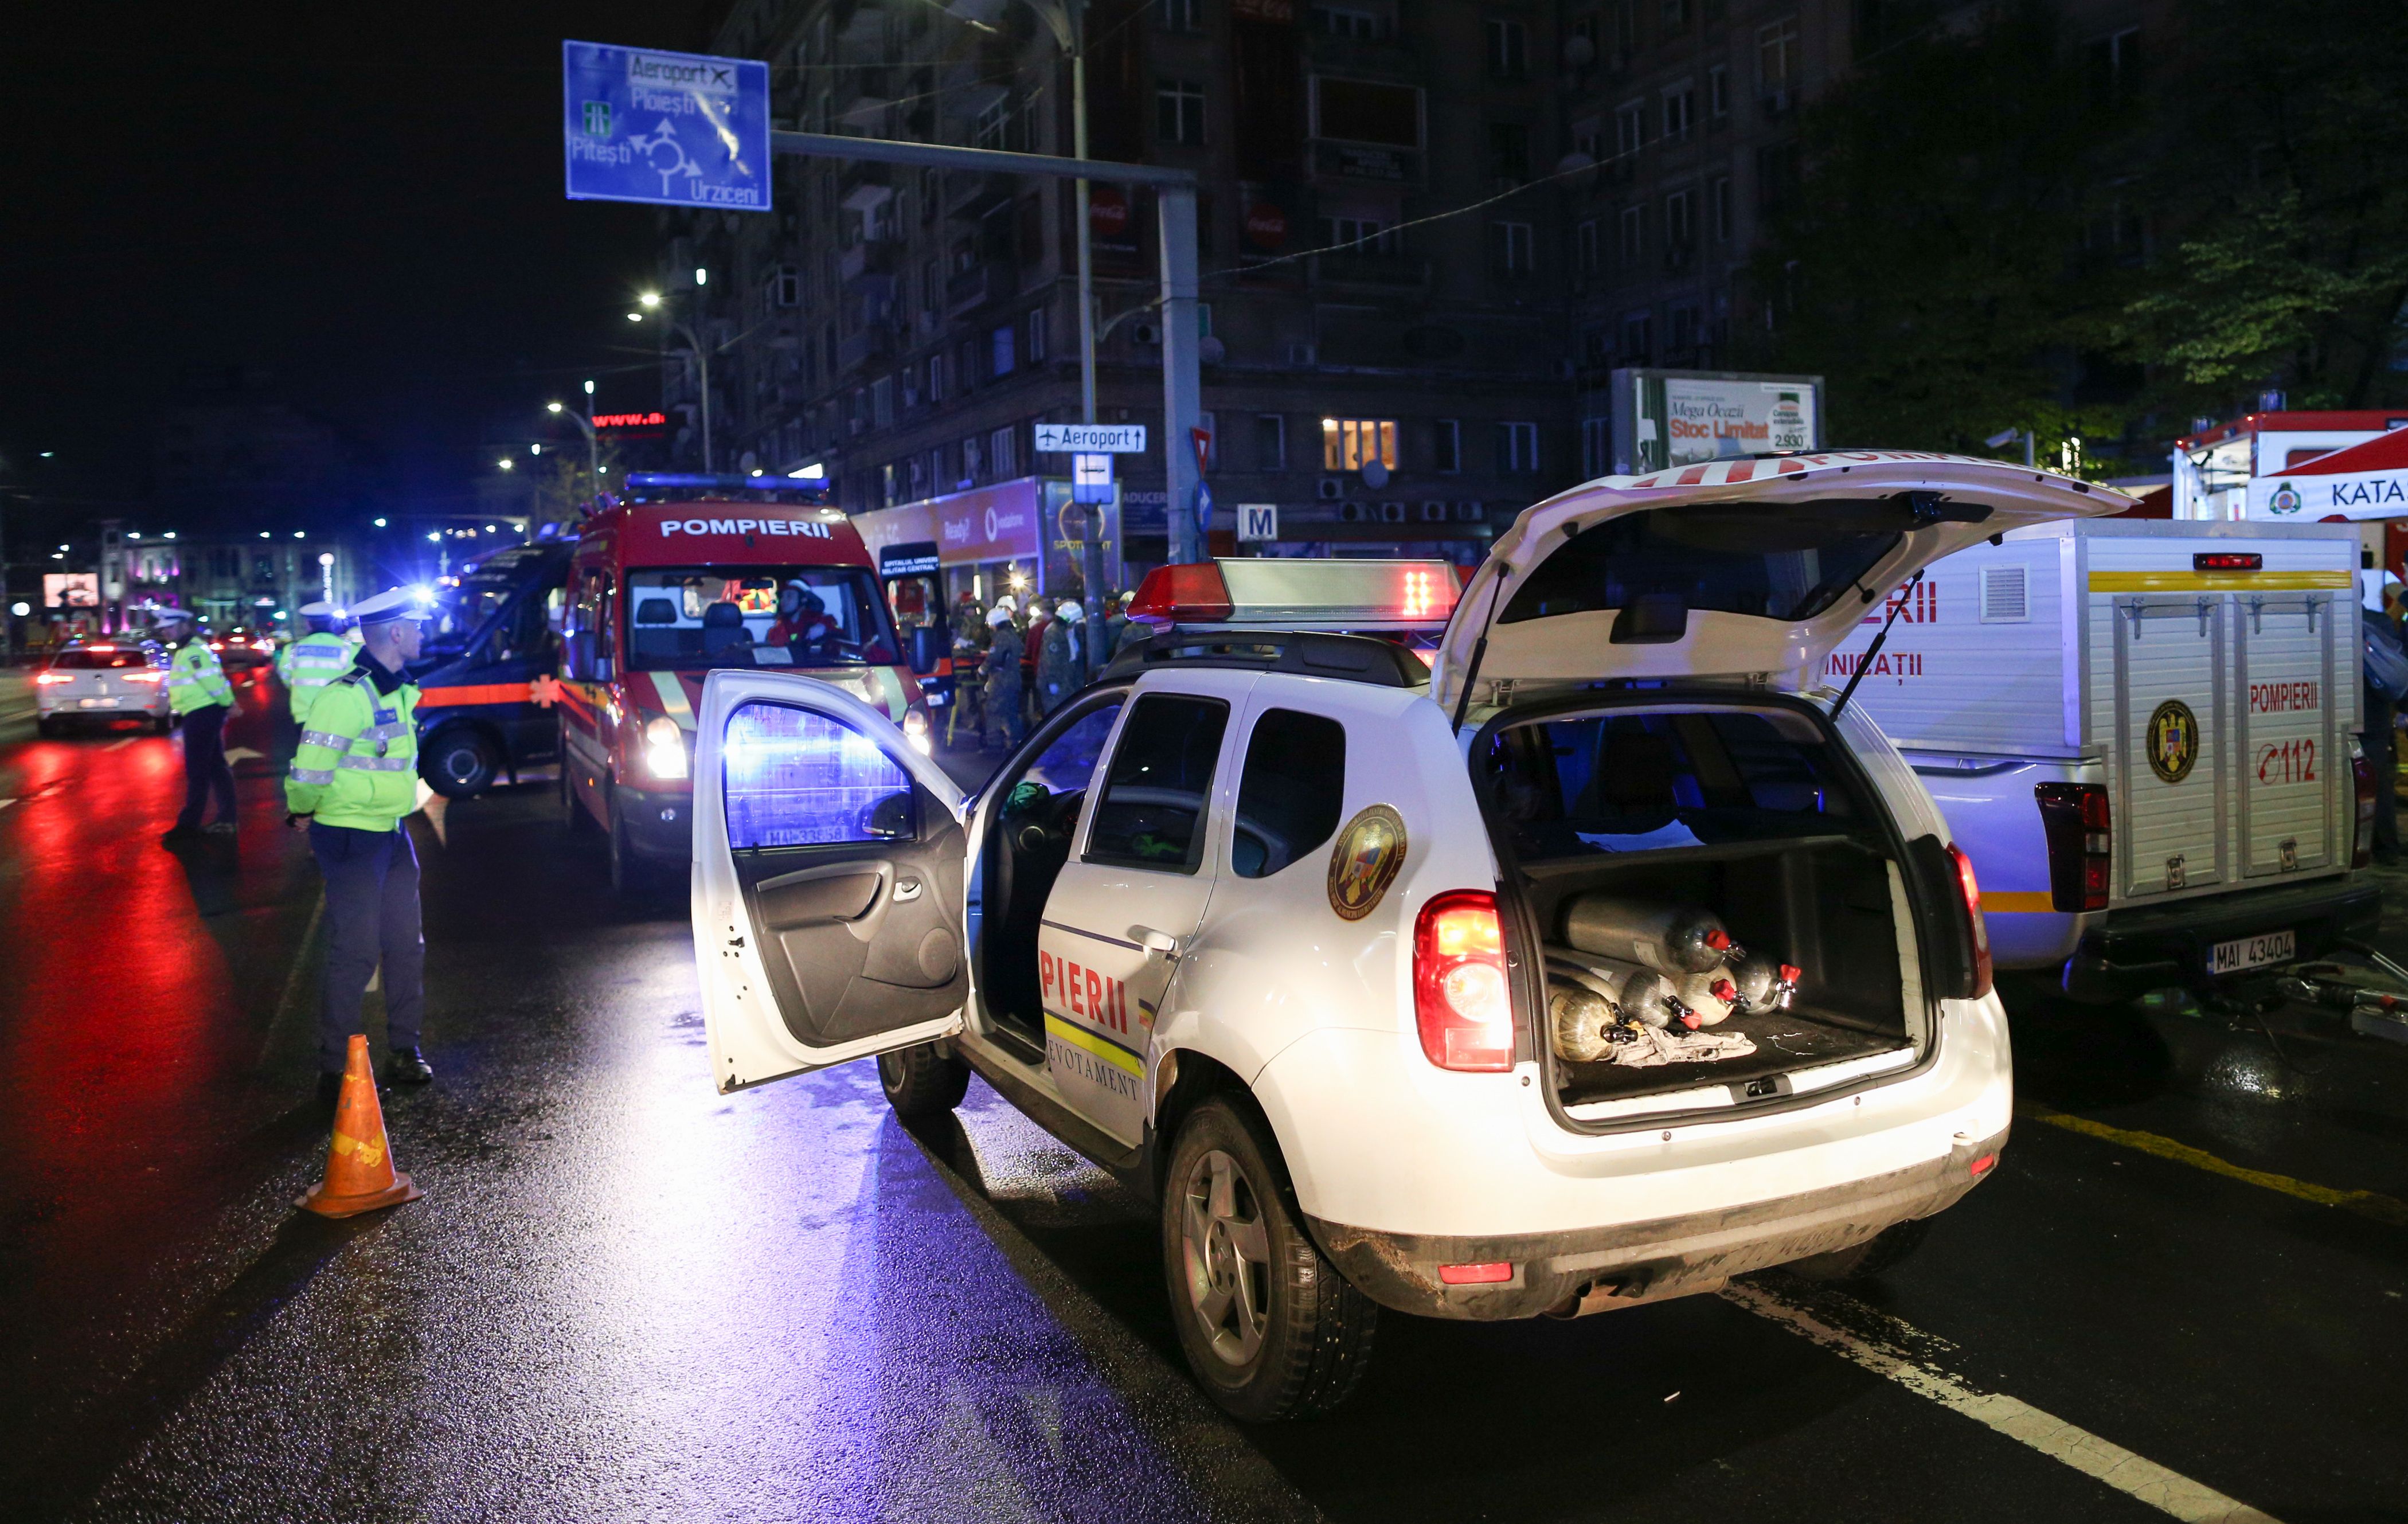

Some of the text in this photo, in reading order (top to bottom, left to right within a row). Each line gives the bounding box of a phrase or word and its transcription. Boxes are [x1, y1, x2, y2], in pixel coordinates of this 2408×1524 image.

[632, 57, 706, 85] Aeroport
[691, 178, 759, 205] Urziceni
[1671, 402, 1744, 420] Mega Ocazii
[1062, 427, 1129, 449] Aeroport
[1670, 419, 1769, 439] Stoc Limitat
[1775, 434, 1803, 447] 2.930
[2332, 479, 2408, 506] KATA
[660, 519, 830, 538] POMPIERII
[1249, 509, 1272, 535] M
[1860, 581, 1936, 624] RII
[2250, 682, 2317, 713] POMPIERII
[2281, 738, 2315, 783] 112
[2217, 934, 2292, 970] MAI 43404
[1040, 949, 1128, 1035] PIERII
[1047, 1039, 1136, 1101] EVOTAMENT
